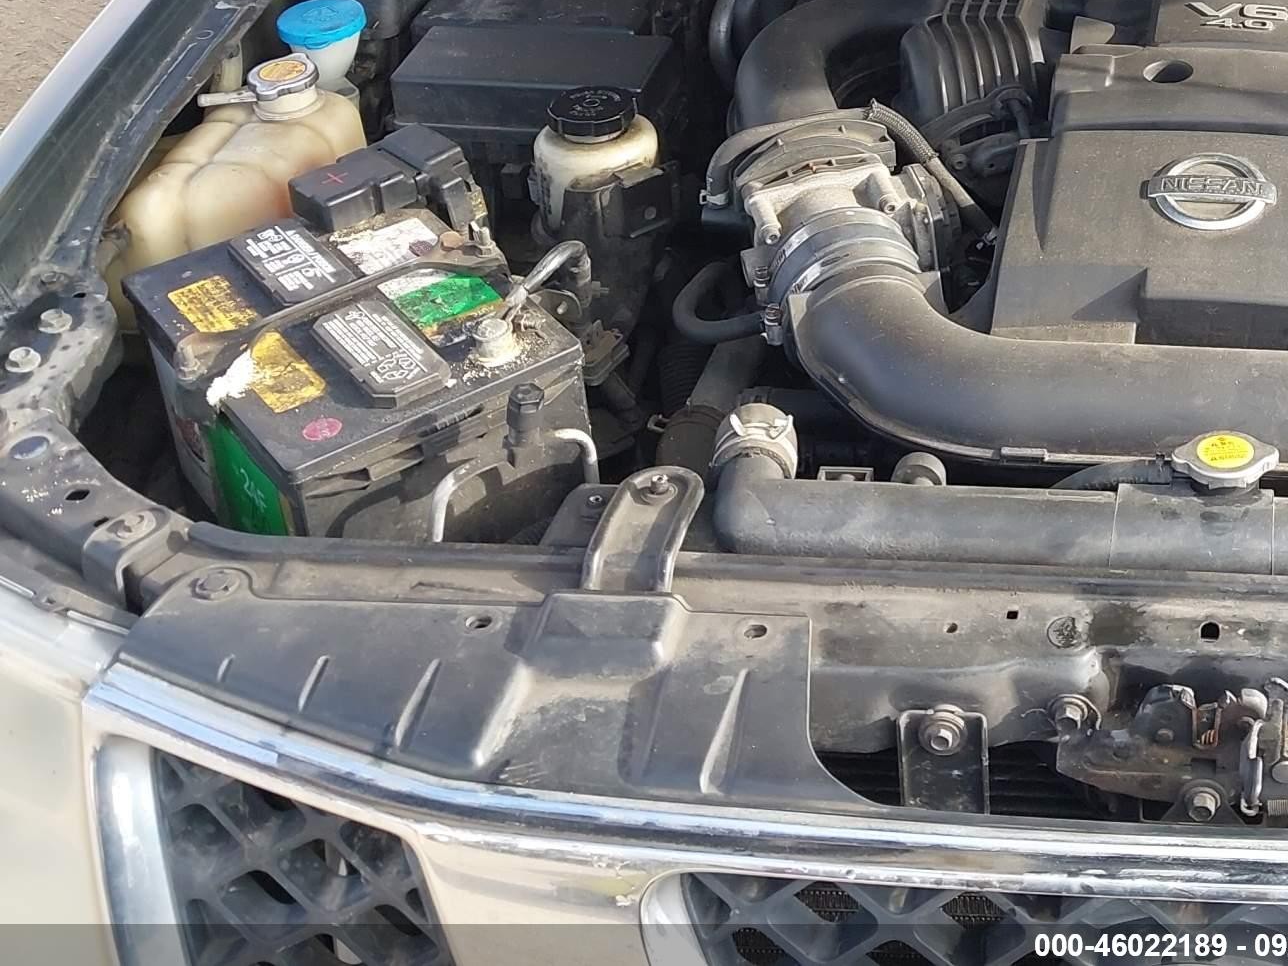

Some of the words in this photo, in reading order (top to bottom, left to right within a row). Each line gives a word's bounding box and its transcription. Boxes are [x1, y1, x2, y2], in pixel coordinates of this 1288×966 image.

[1185, 1, 1288, 21] V6
[1201, 17, 1275, 31] 4.0
[1160, 176, 1263, 195] NISSAN
